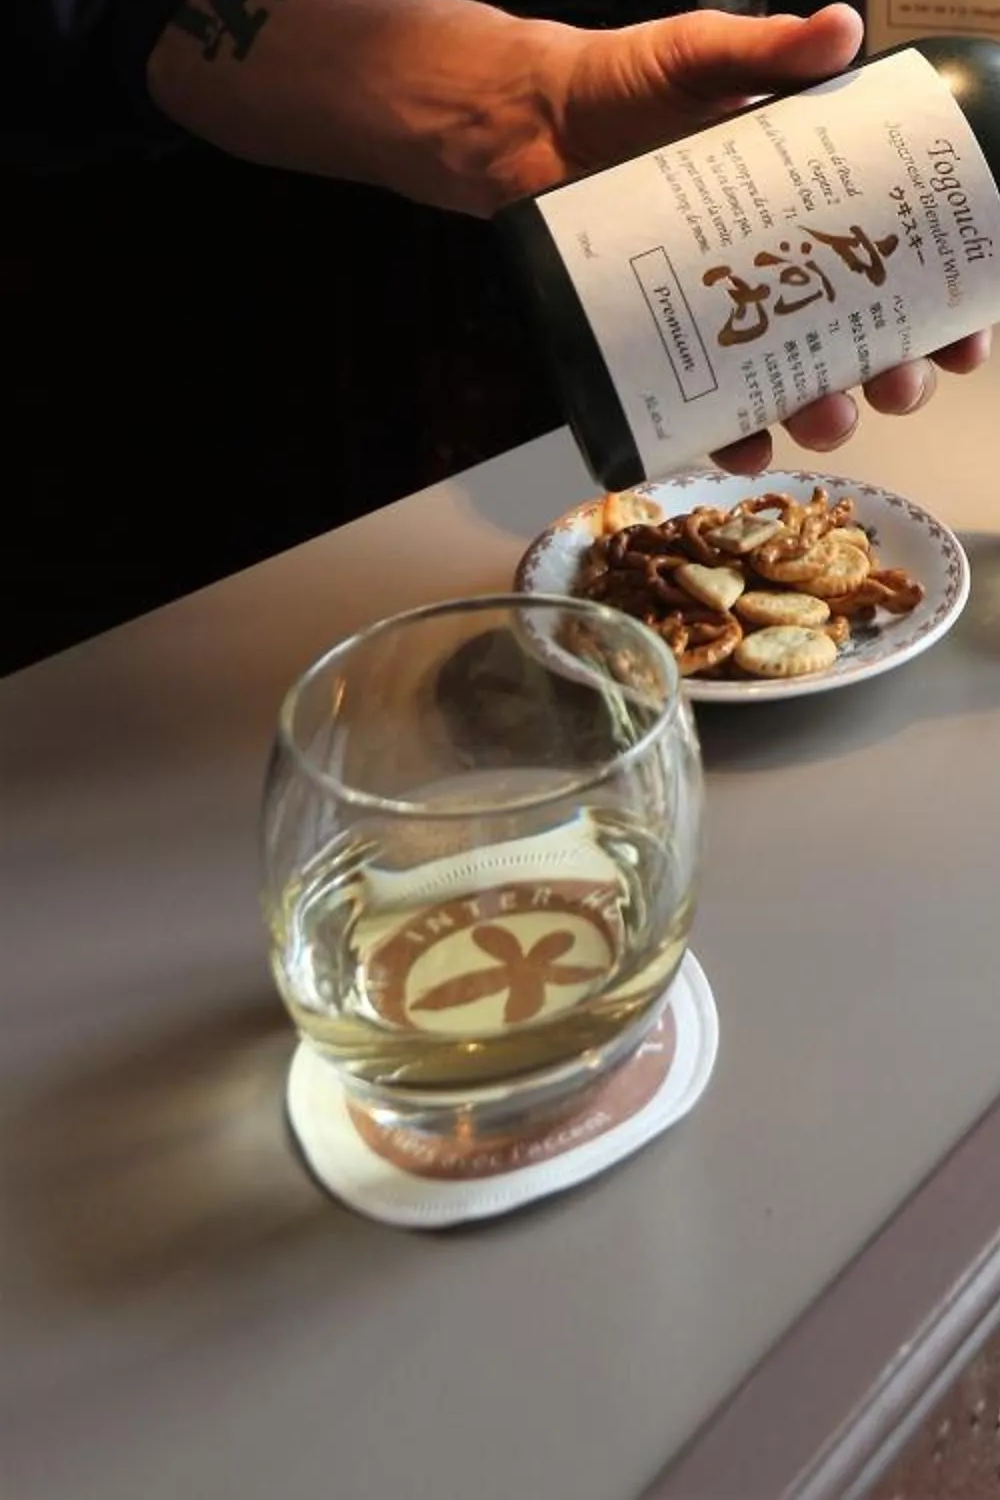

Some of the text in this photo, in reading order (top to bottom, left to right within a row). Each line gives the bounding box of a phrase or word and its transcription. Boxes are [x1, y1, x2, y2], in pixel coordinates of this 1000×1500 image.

[887, 124, 926, 190] Japanese
[918, 191, 954, 256] Blended
[927, 138, 993, 262] Togouchi
[652, 284, 695, 371] Premium
